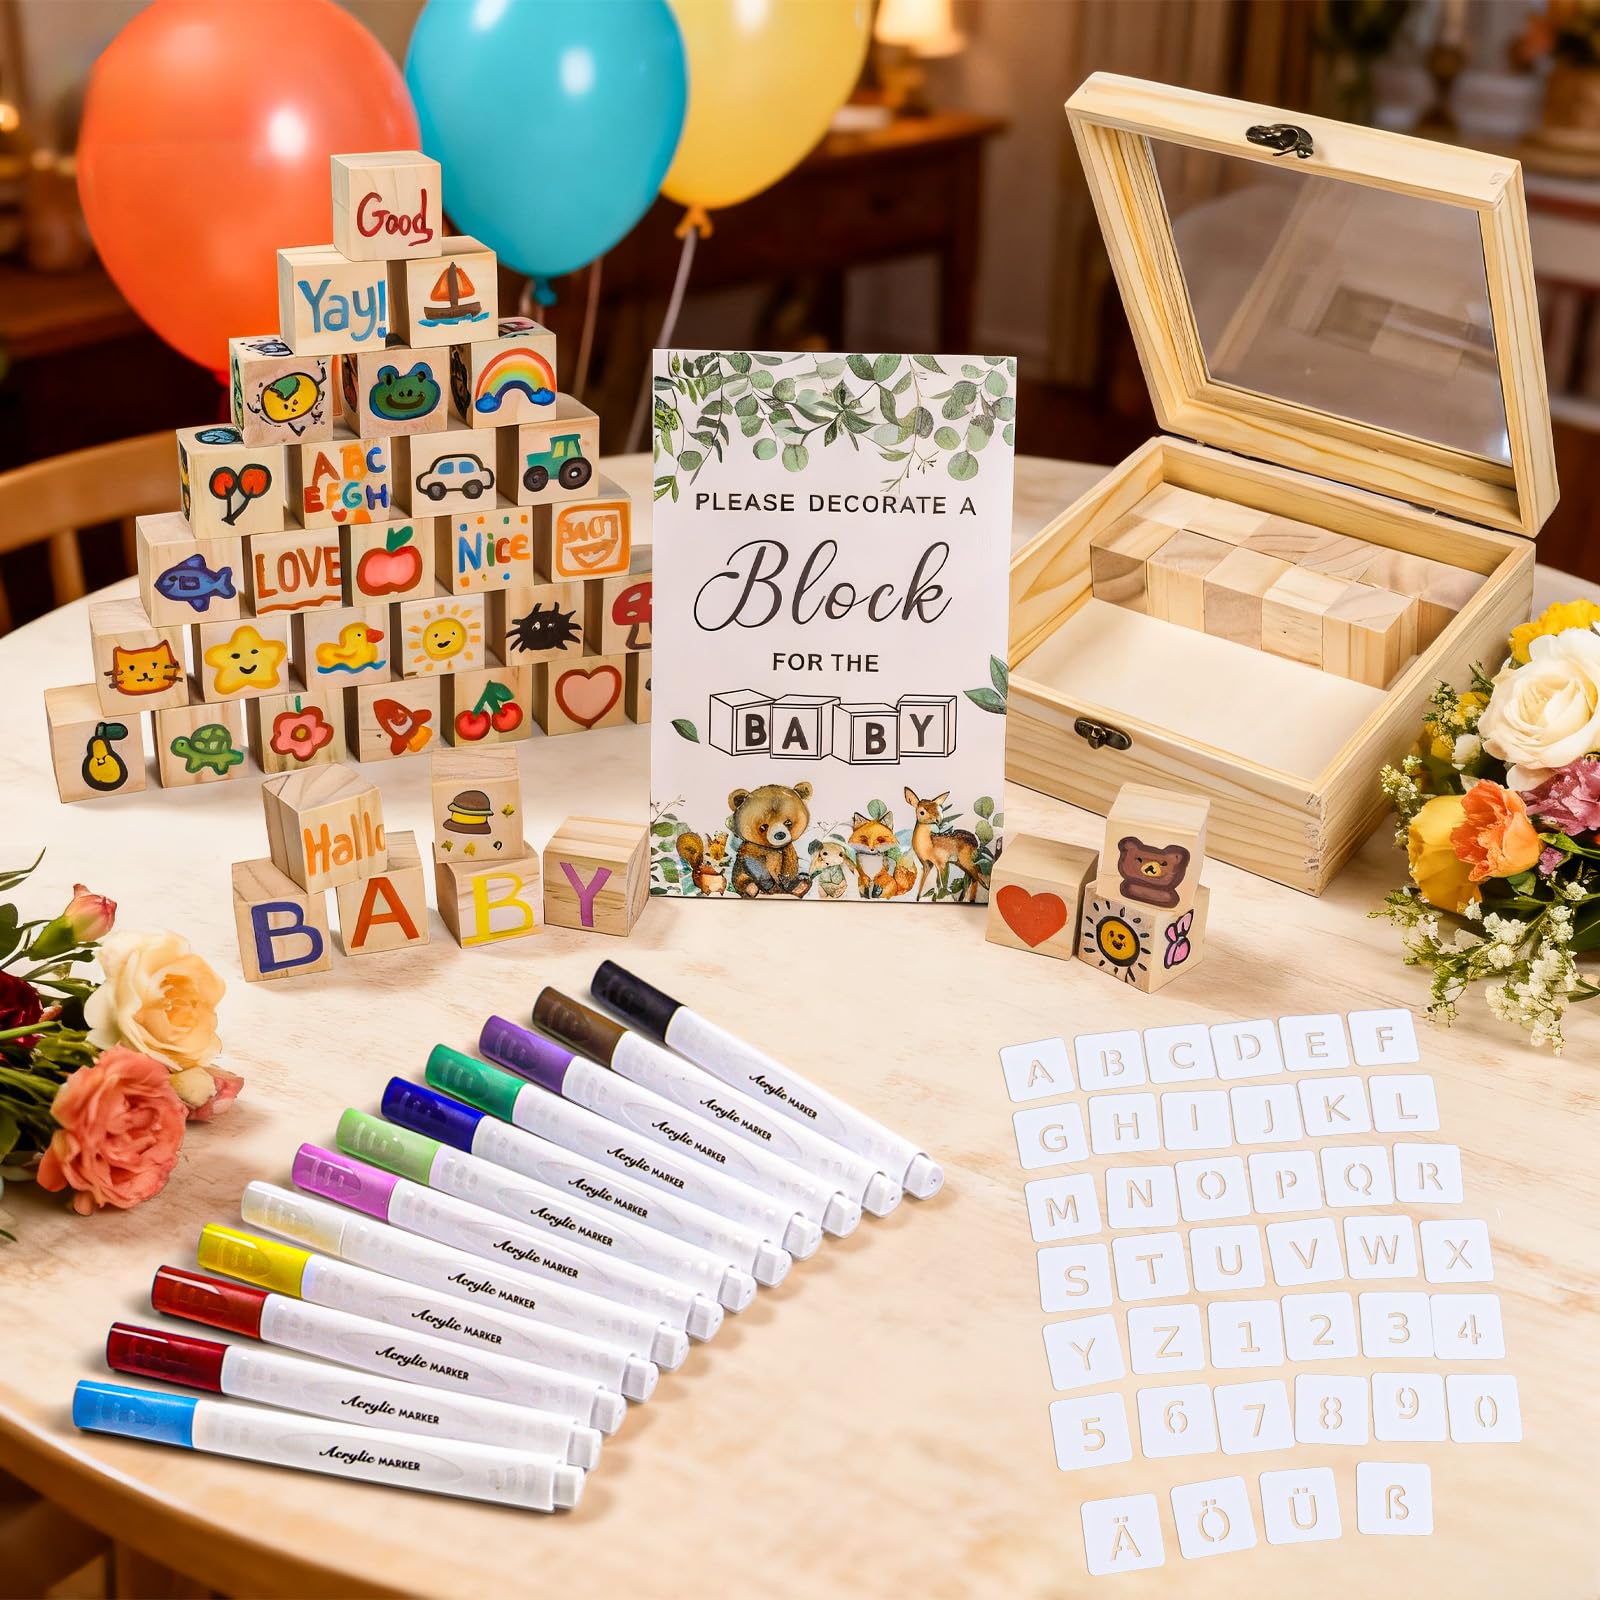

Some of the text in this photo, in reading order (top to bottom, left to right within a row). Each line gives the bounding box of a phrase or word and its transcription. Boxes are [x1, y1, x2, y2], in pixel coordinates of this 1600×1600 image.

[356, 188, 434, 247] Good
[297, 278, 387, 342] Yay!
[695, 492, 978, 517] PLEASE DECORATE A
[255, 546, 342, 599] LOVE
[693, 539, 953, 632] Block
[772, 652, 880, 674] FOR THE
[1027, 1027, 1393, 1087] A B C D E F
[749, 1075, 818, 1120] Acrylic MARKER
[699, 1099, 773, 1142] Acrylic MARKER
[1038, 1124, 1068, 1152] G
[1112, 1112, 1139, 1141] H
[1324, 1095, 1351, 1122] K
[1397, 1093, 1418, 1120] L
[651, 1121, 726, 1165] Acrylic MARKER
[607, 1148, 685, 1190] Acrylic MARKER
[568, 1178, 648, 1219] Acrylic MARKER
[1045, 1195, 1079, 1228] M
[1126, 1179, 1153, 1208] N
[1275, 1170, 1297, 1198] P
[1343, 1163, 1373, 1196] Q
[1417, 1162, 1444, 1190] R
[530, 1207, 613, 1247] Acrylic MARKER
[493, 1240, 579, 1279] Acrylic MARKER
[1064, 1234, 1473, 1296] S T U V W X
[447, 1272, 536, 1311] Acrylic MARKER
[411, 1309, 502, 1345] Acrylic MARKER
[1070, 1337, 1096, 1370] Y
[1153, 1324, 1182, 1358] Z
[1310, 1314, 1334, 1346] 2
[1387, 1312, 1411, 1343] 3
[1459, 1314, 1481, 1345] 4
[375, 1346, 470, 1381] Acrylic MARKER
[341, 1395, 440, 1425] Acrylic MARKER
[1081, 1418, 1106, 1451] 5
[1163, 1400, 1188, 1434] 6
[1243, 1404, 1267, 1437] 7
[1319, 1396, 1343, 1430] 8
[1395, 1387, 1419, 1420] 9
[319, 1445, 421, 1472] Acrylic MARKER
[1110, 1516, 1141, 1561] Ä
[1198, 1499, 1230, 1542] Ö
[1289, 1487, 1318, 1530] Ü
